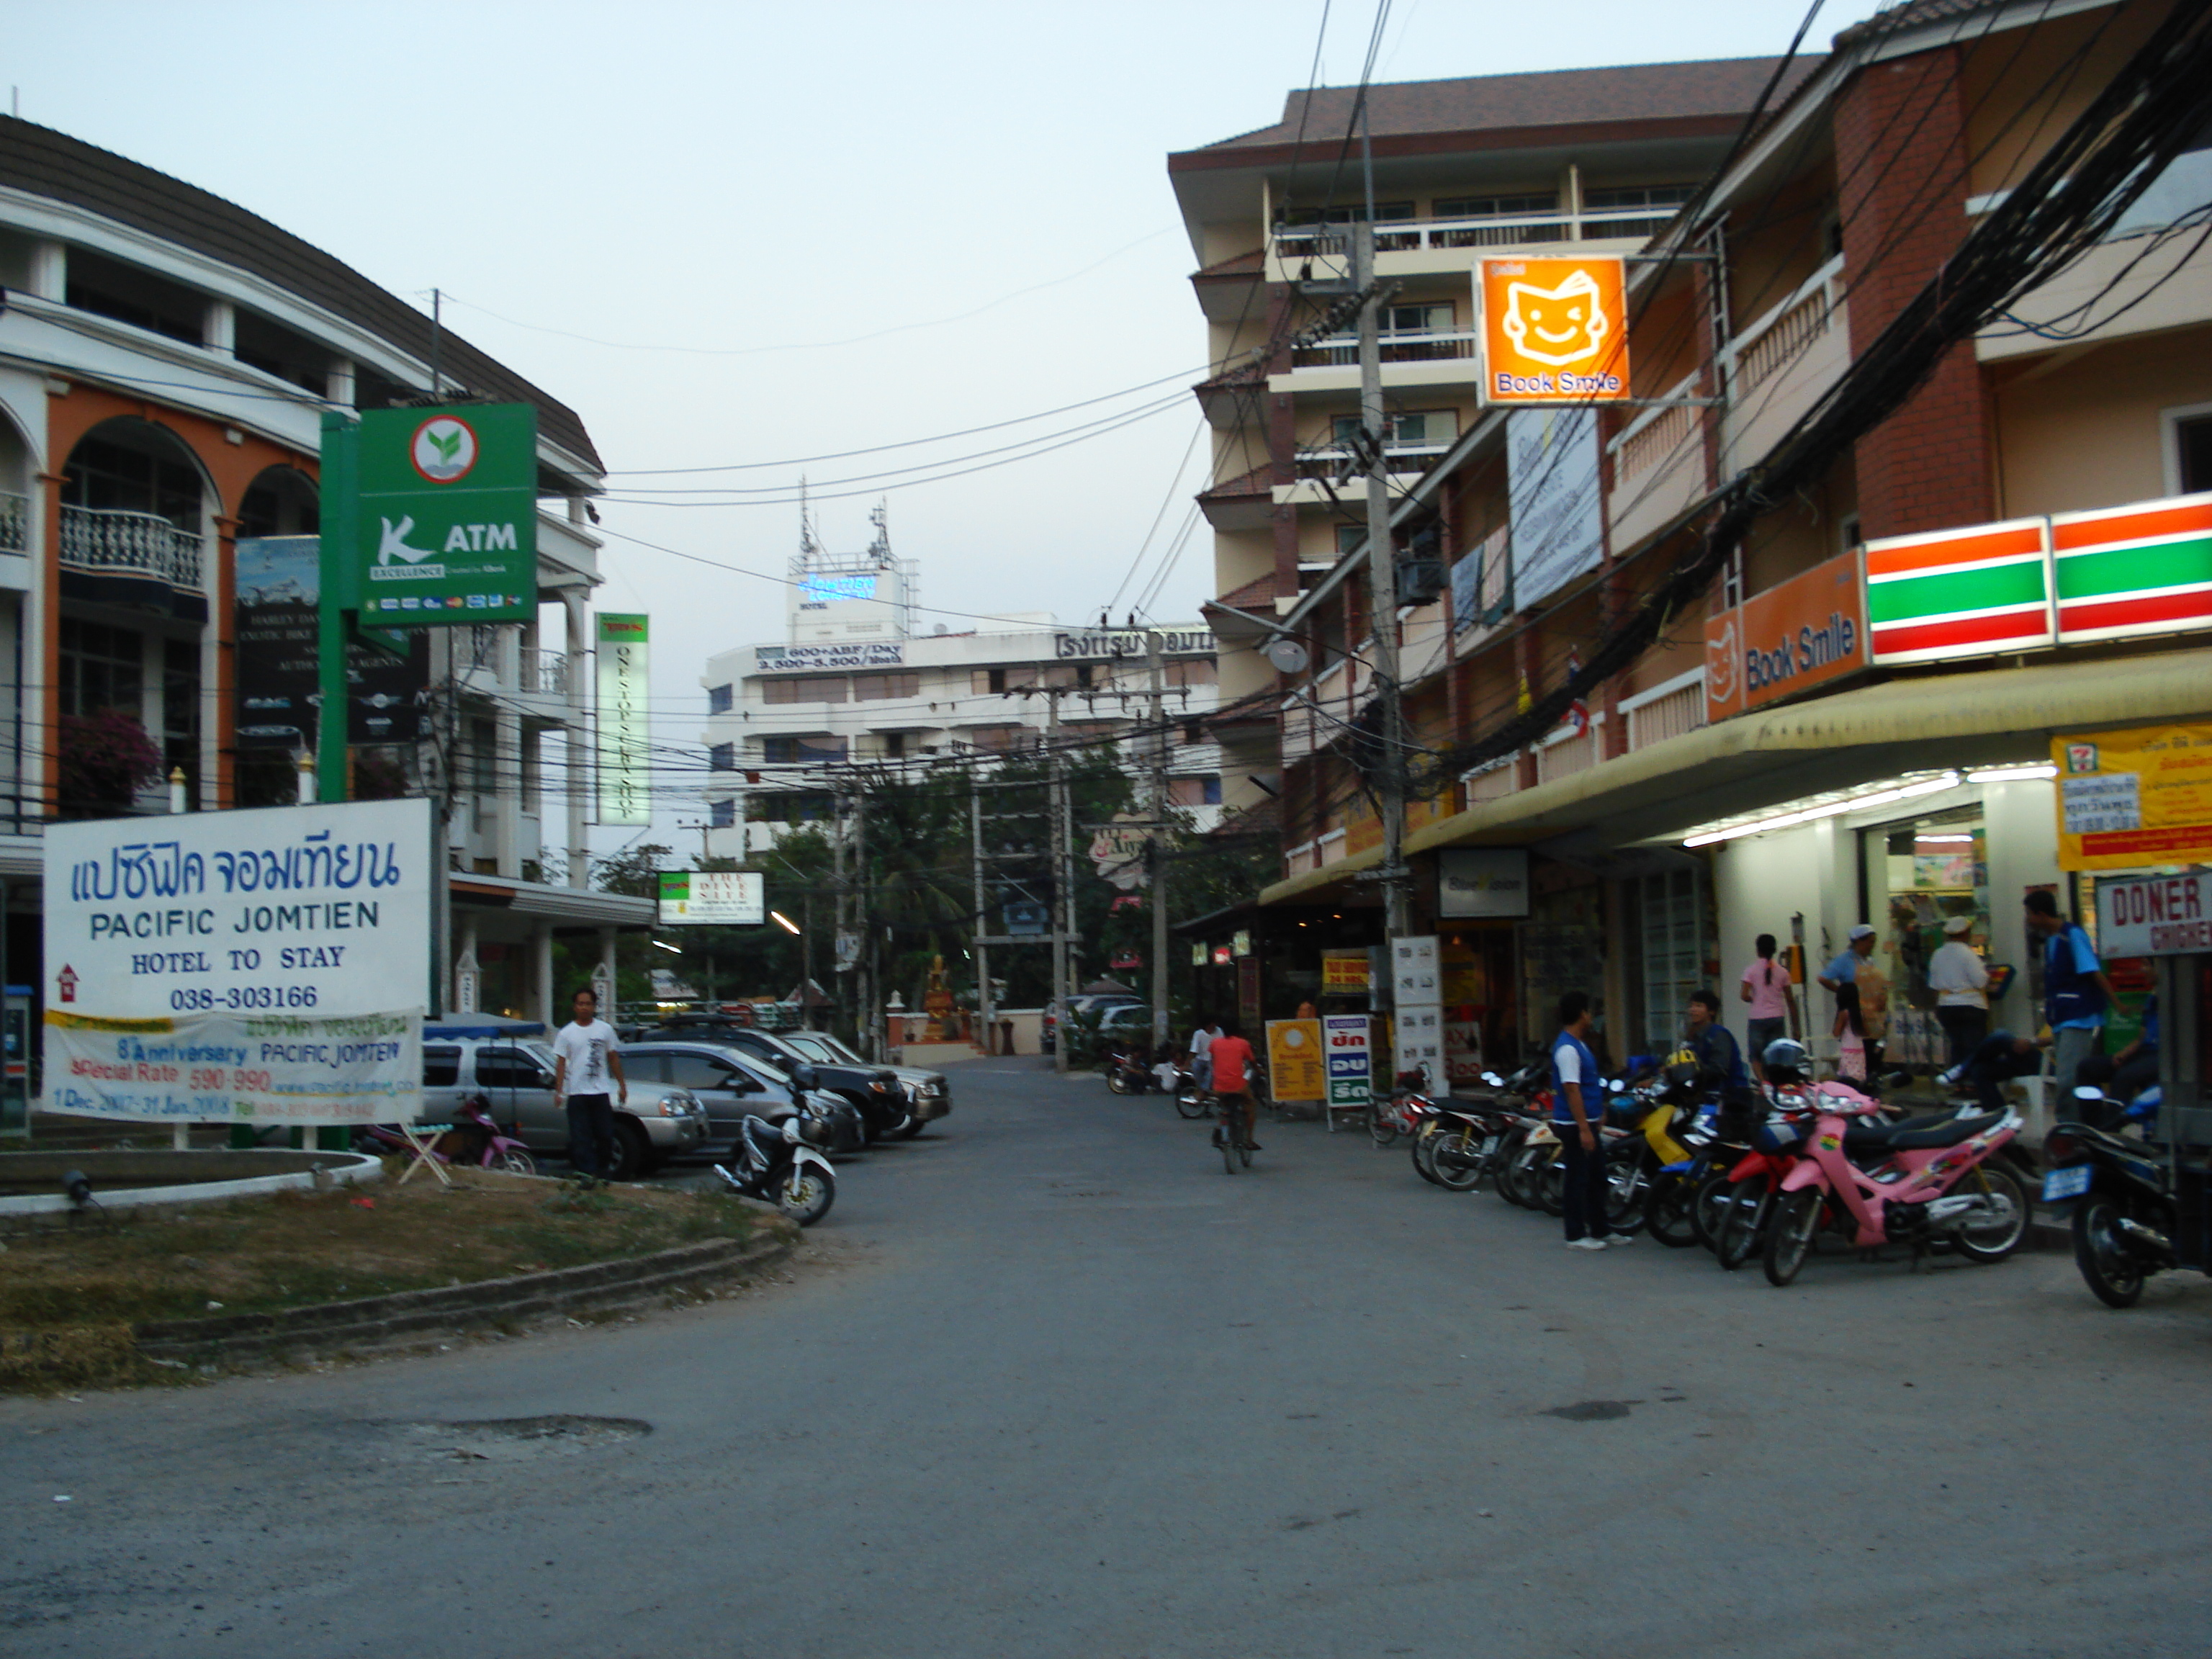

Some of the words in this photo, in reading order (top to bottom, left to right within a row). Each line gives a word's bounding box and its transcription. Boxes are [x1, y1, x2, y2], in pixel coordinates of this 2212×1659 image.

[1496, 372, 1555, 392] Book
[1559, 371, 1620, 392] Smile
[378, 514, 438, 567] K
[444, 522, 518, 553] ATM
[1747, 634, 1797, 692] Book
[1799, 611, 1855, 672] Smile
[214, 830, 401, 893] จอมเทียน
[2112, 877, 2202, 927] DONER
[89, 908, 215, 940] PACIFIC
[233, 901, 379, 934] JOMTIEN
[2150, 920, 2212, 950] CHICKE
[131, 951, 212, 975] HOTEL
[228, 948, 261, 971] TO
[279, 945, 346, 969] STAY
[170, 986, 318, 1011] 038-303166
[132, 1043, 248, 1067] Anniversary
[260, 1043, 328, 1063] PACIFIC
[135, 1062, 179, 1083] Rate
